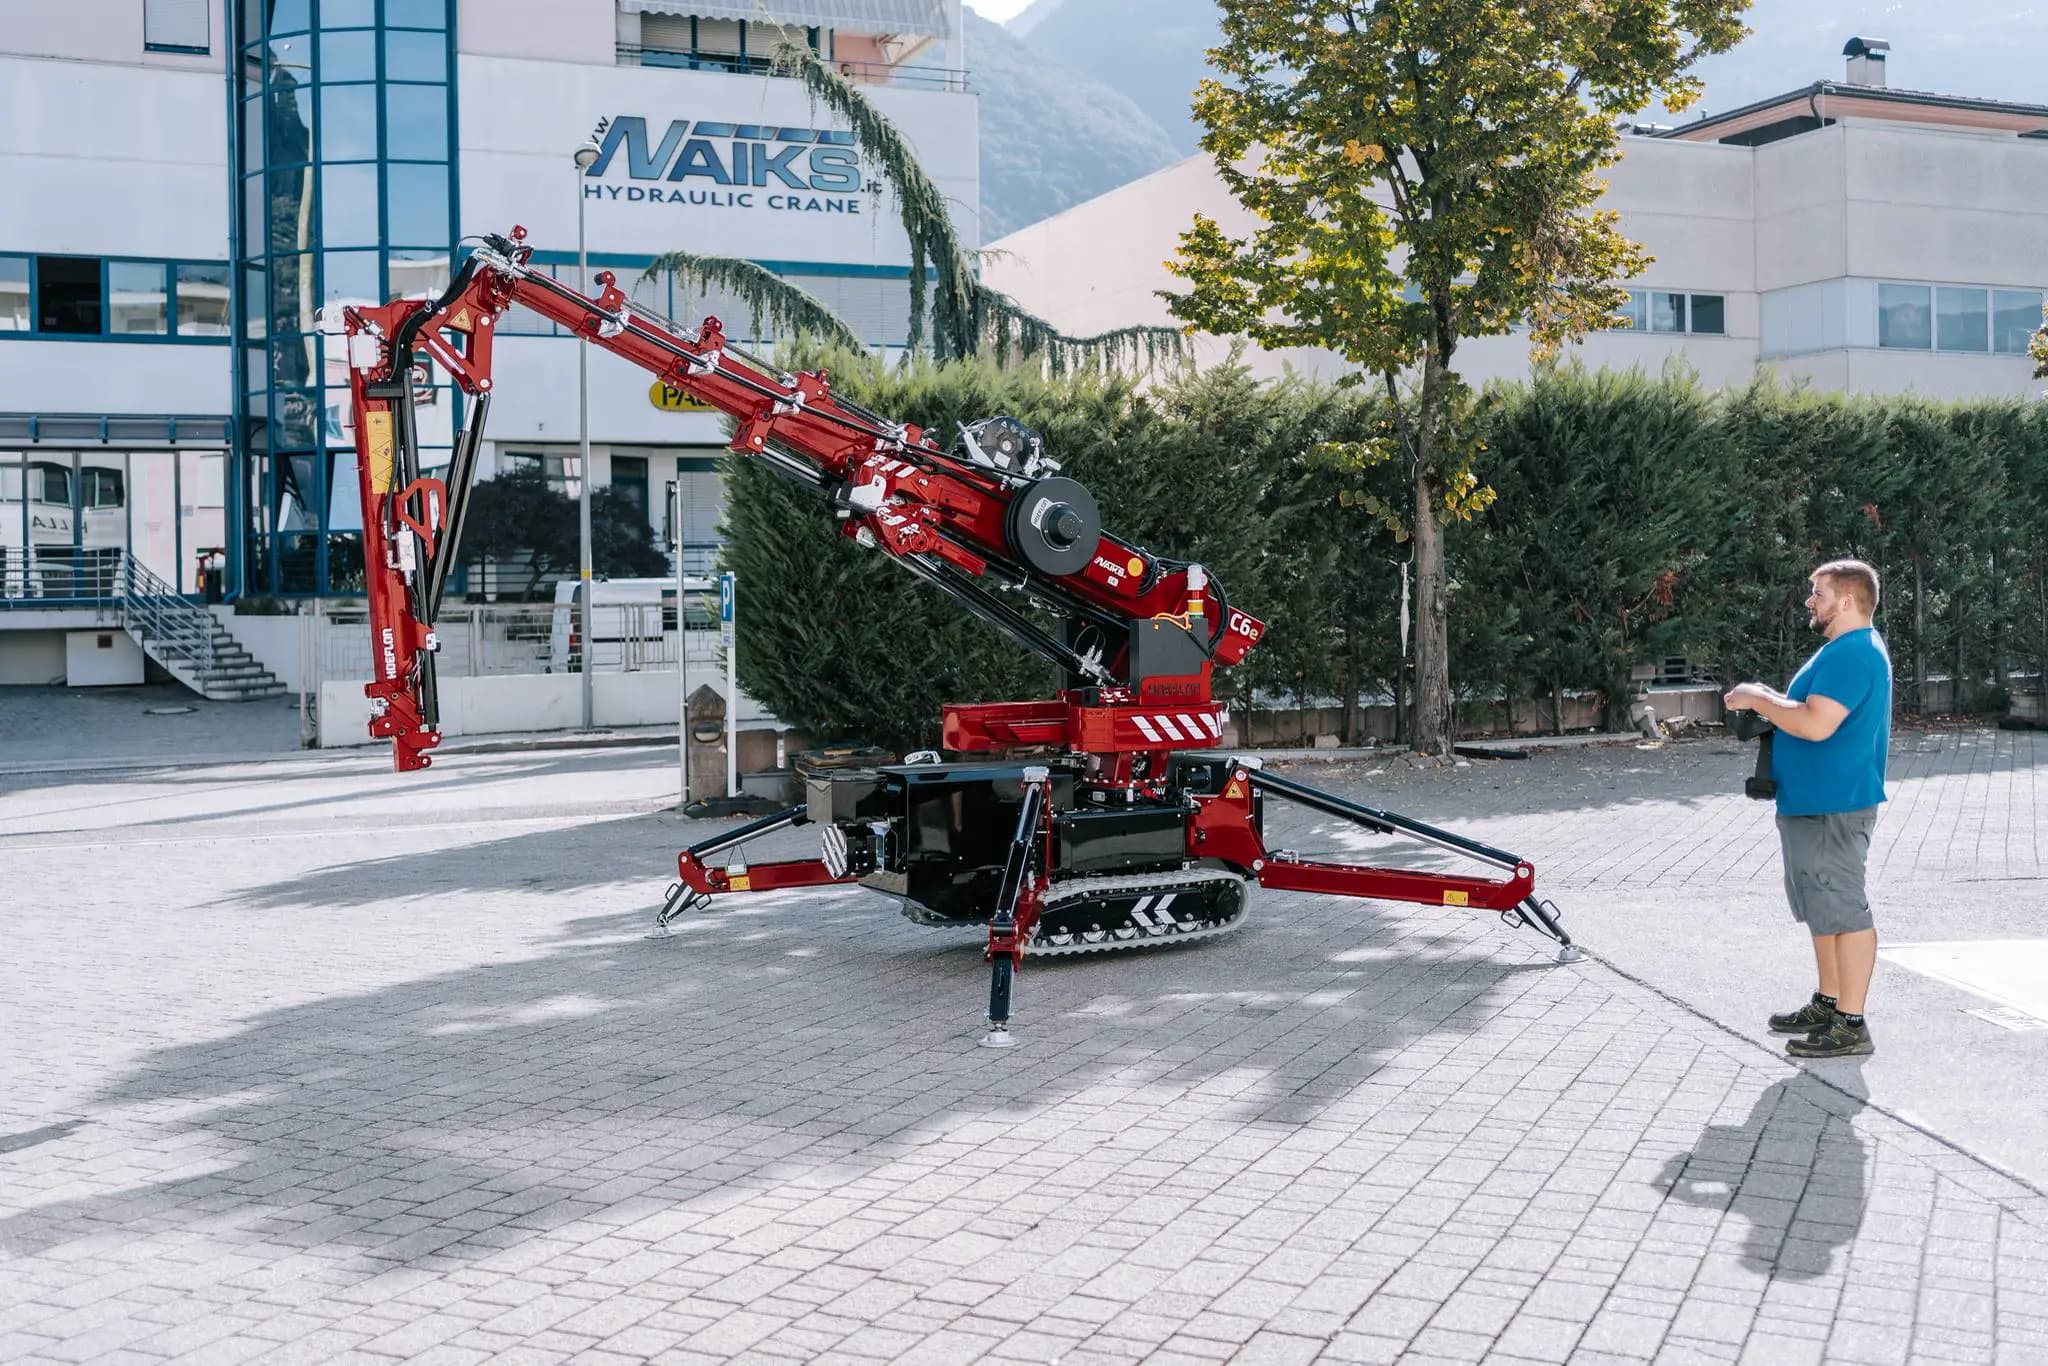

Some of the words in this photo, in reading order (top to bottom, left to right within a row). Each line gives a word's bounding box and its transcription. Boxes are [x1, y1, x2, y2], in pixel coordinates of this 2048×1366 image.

[584, 183, 753, 208] HYDRAULIC
[767, 194, 860, 214] CRANE
[722, 580, 730, 617] P
[1230, 612, 1259, 641] C6e
[382, 627, 398, 680] HOEFLON
